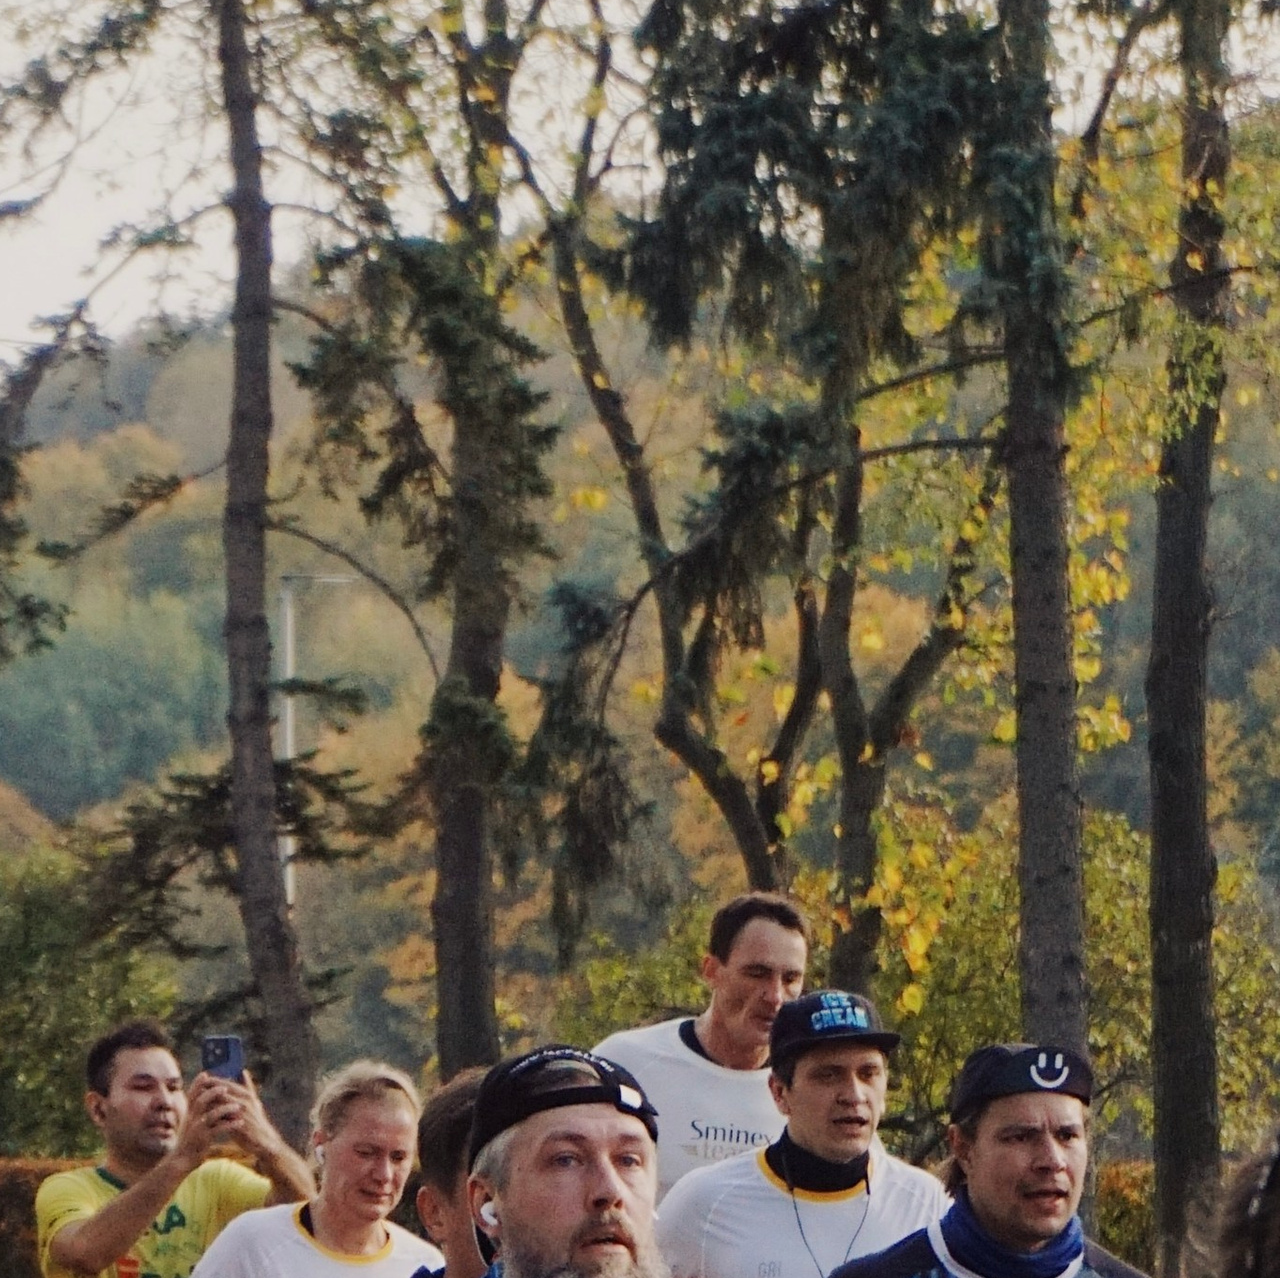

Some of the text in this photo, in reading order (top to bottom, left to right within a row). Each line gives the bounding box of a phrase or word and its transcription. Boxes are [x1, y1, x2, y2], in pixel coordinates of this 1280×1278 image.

[820, 992, 851, 1007] ICE
[810, 1006, 869, 1030] CREAM
[690, 1119, 773, 1147] Sminex
[703, 1140, 749, 1160] tea
